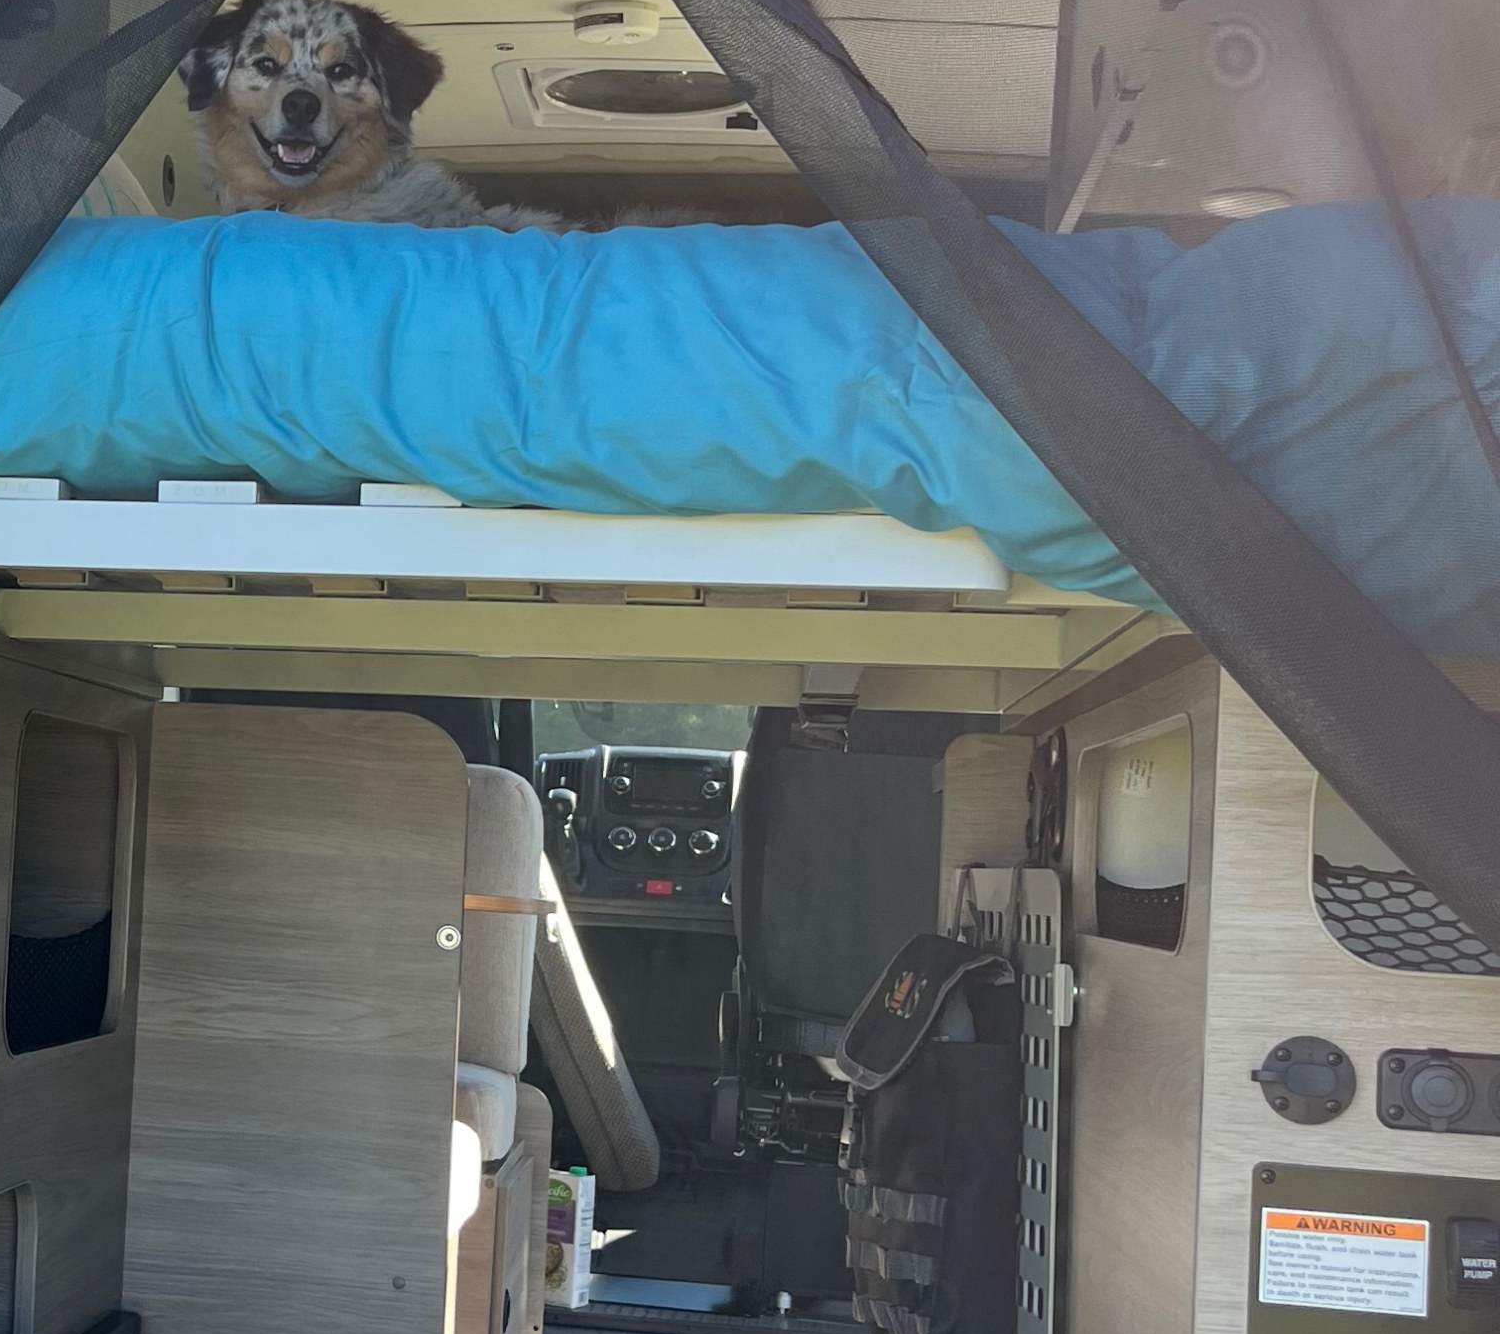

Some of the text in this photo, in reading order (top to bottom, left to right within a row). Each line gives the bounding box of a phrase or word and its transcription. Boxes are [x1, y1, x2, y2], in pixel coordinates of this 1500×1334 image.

[1313, 1218, 1395, 1235] WARNING
[1461, 1257, 1496, 1268] WATER
[1464, 1269, 1493, 1279] PUMP
